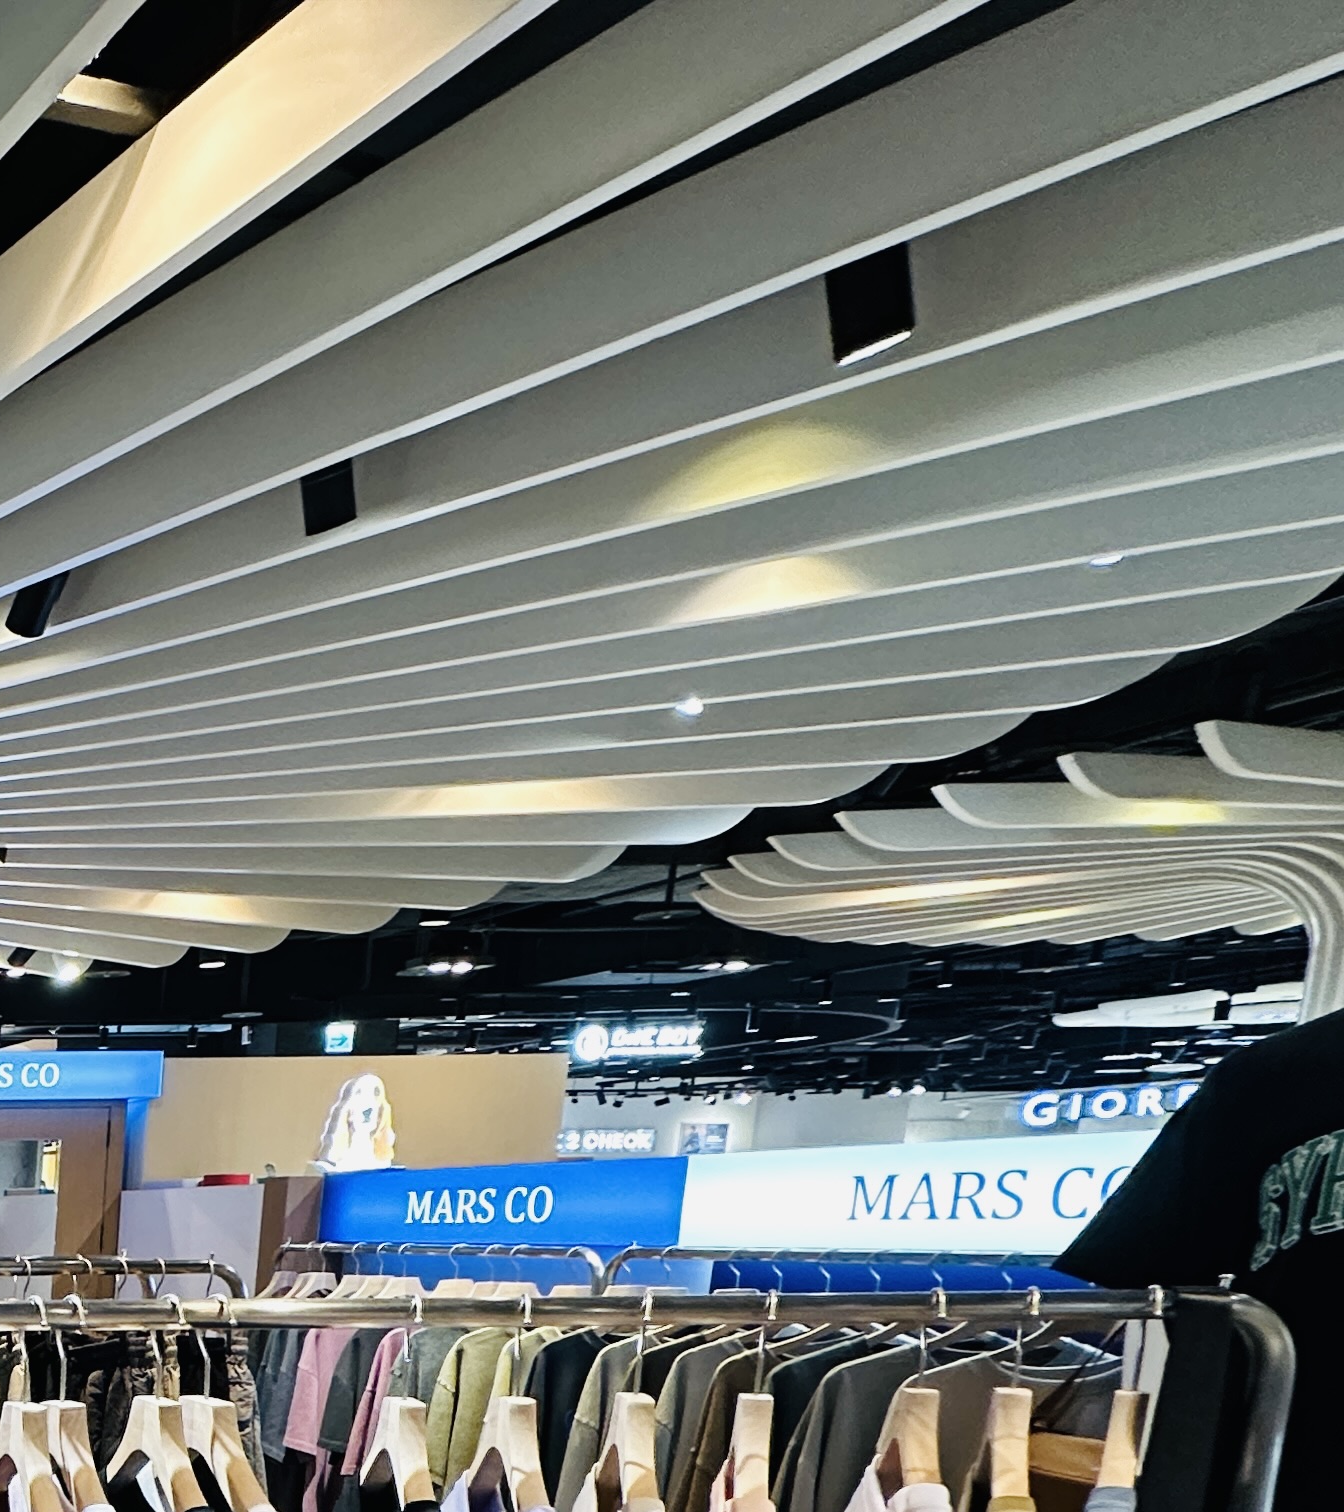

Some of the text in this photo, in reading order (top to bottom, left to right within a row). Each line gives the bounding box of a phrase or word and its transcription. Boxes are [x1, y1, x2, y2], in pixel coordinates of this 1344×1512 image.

[21, 1062, 61, 1089] CO
[404, 1185, 554, 1226] MARS CO
[847, 1169, 1029, 1221] MARS
